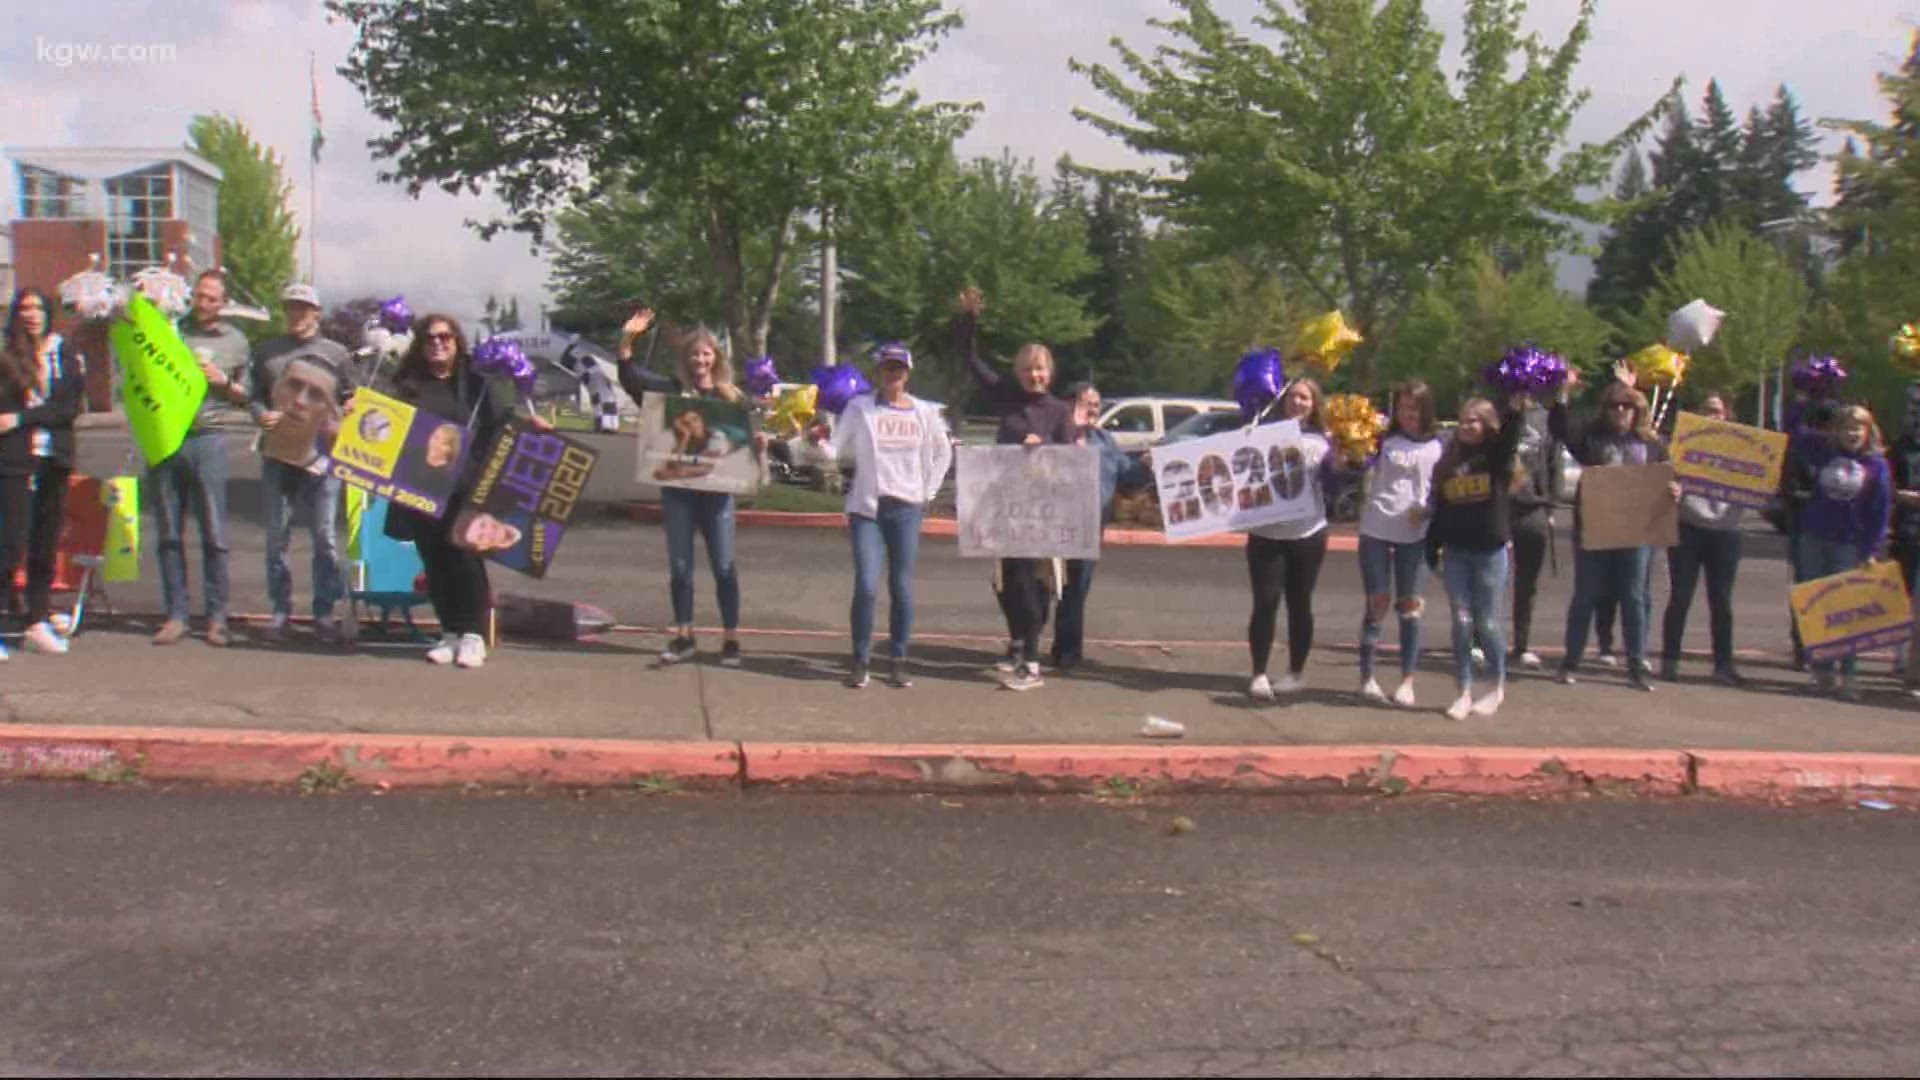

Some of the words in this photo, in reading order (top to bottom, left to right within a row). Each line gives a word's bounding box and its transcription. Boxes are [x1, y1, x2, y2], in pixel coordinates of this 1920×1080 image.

[394, 488, 437, 513] 2020
[501, 431, 565, 511] JEB
[539, 446, 595, 522] 2020
[1162, 445, 1306, 524] 2020
